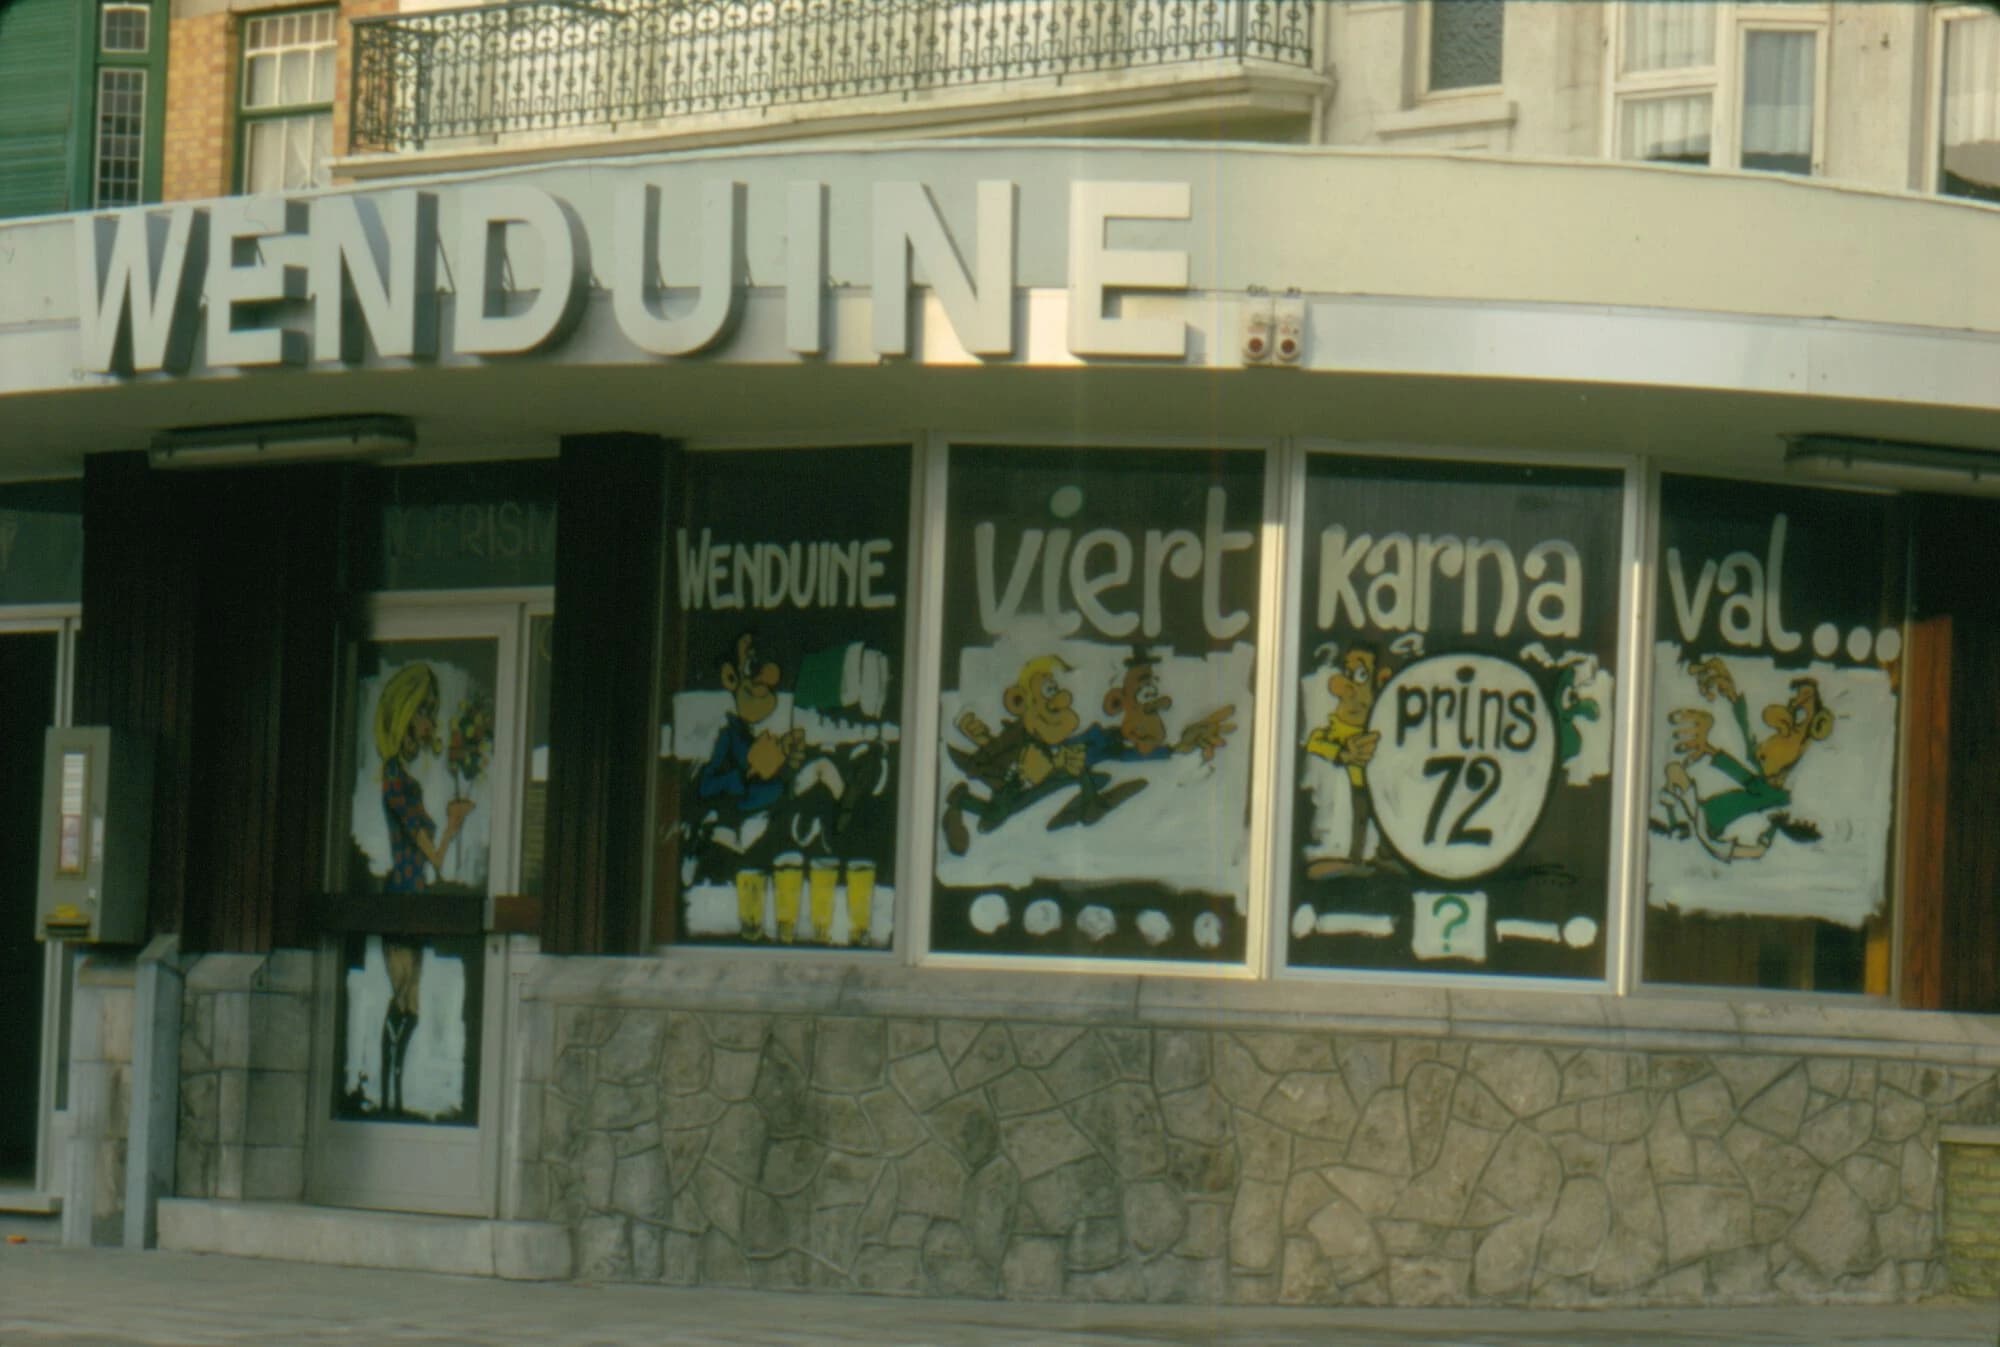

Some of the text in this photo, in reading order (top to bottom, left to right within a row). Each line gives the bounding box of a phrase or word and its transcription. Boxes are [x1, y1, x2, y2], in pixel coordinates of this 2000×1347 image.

[73, 180, 1191, 372] WENDUINE
[676, 527, 897, 611] WENDUINE
[974, 485, 1254, 639] viert
[1318, 523, 1583, 639] karna
[1395, 665, 1538, 752] prins
[1422, 755, 1502, 847] 72
